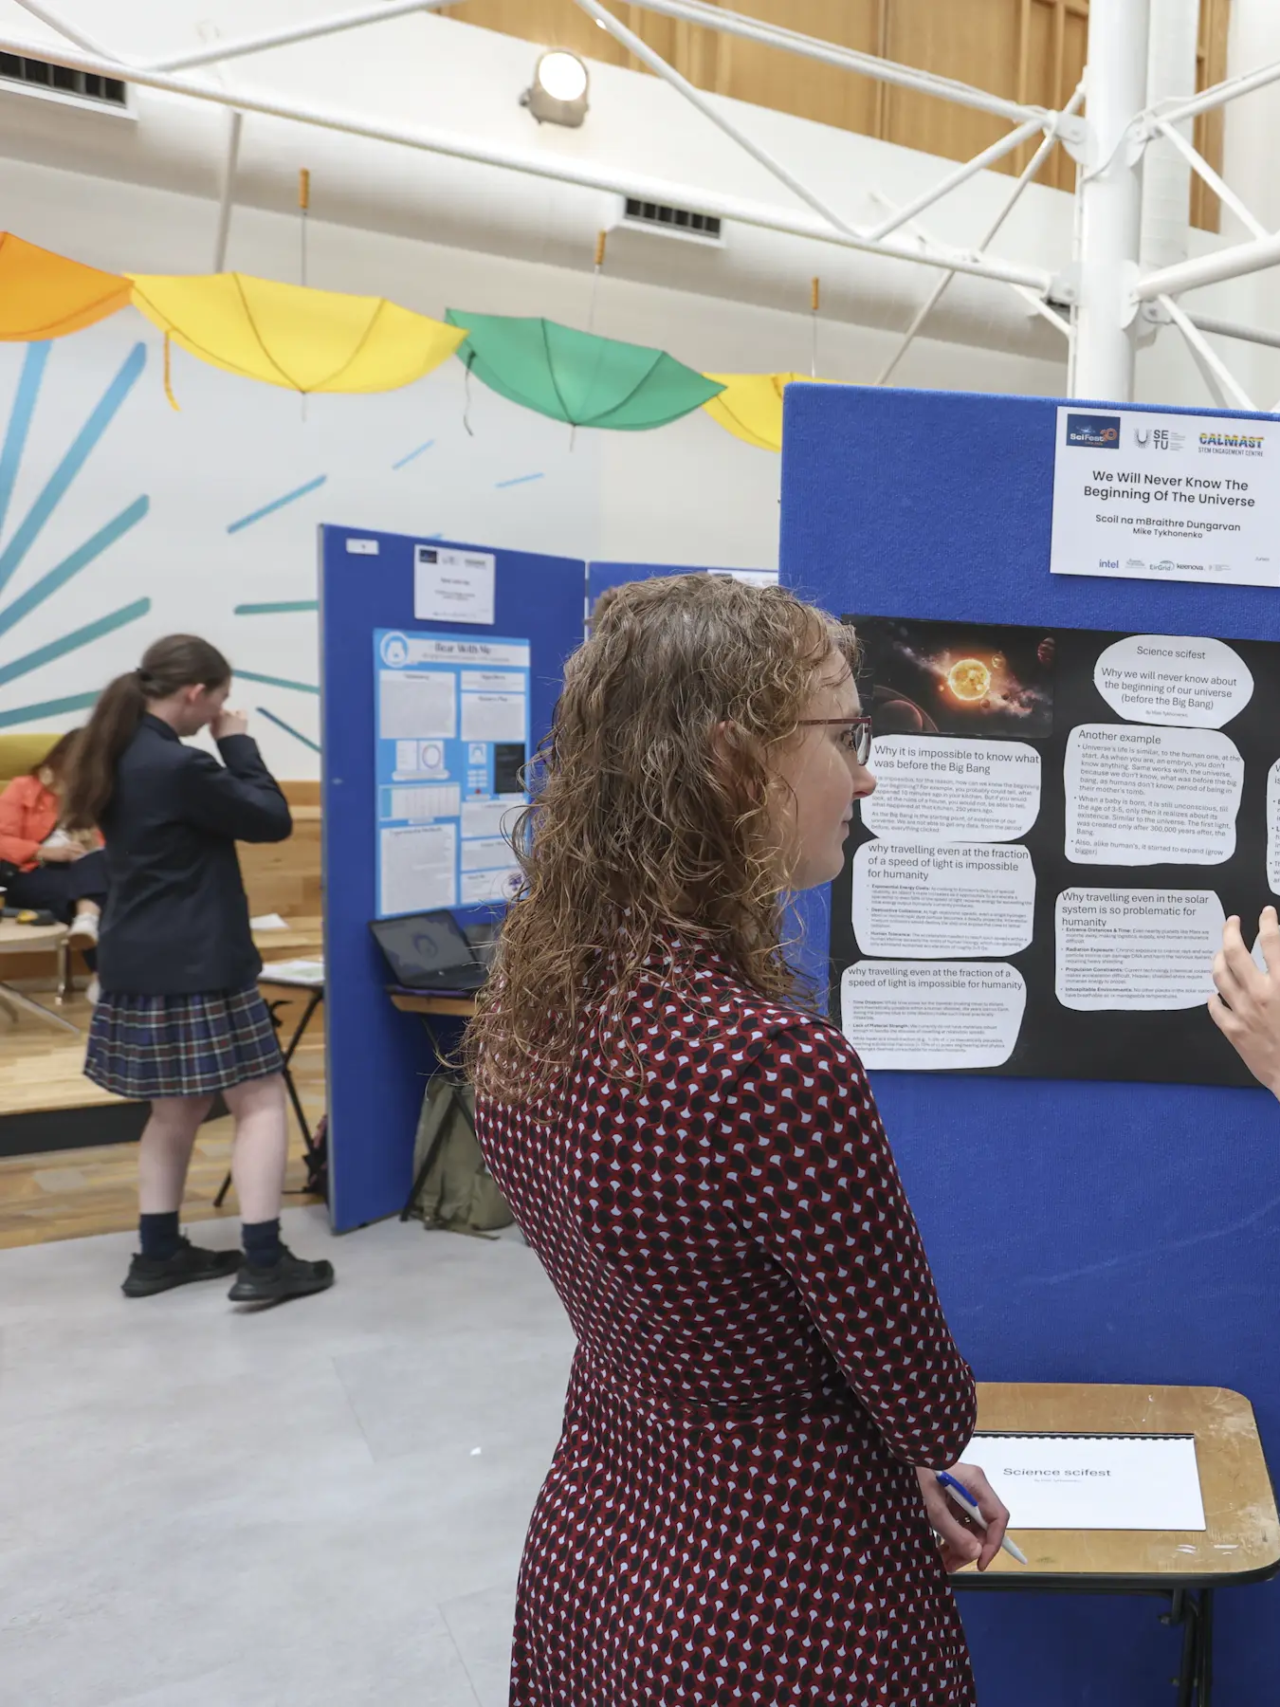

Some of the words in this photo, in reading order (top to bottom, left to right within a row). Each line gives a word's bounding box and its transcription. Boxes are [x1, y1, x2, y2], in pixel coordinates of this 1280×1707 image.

[1070, 432, 1104, 442] SciFest
[1154, 430, 1168, 440] SE
[1199, 433, 1264, 449] CALMAST
[1154, 440, 1168, 450] TU
[1212, 448, 1244, 456] ENGAGEMENT
[1093, 471, 1114, 482] We
[1117, 472, 1141, 484] Will
[1144, 474, 1182, 486] Never
[1186, 477, 1222, 489] Know
[1225, 480, 1248, 491] The
[1084, 486, 1150, 504] Beginning
[1154, 491, 1168, 501] Of
[1172, 492, 1195, 503] The
[1199, 494, 1255, 507] Universe
[1096, 514, 1119, 523] Scoil
[1136, 518, 1185, 528] mBraithre
[1187, 520, 1241, 532] Dungarvan
[1154, 530, 1203, 539] Tykhonenko
[1099, 559, 1119, 569] intel
[1137, 646, 1173, 657] Science
[1175, 650, 1206, 660] scifest
[1102, 667, 1123, 679] Why
[1140, 671, 1156, 680] will
[1158, 674, 1183, 682] never
[1185, 674, 1209, 684] know
[1211, 676, 1237, 686] about
[1105, 680, 1120, 690] the
[1122, 682, 1165, 695] beginning
[1166, 685, 1176, 694] of
[1194, 688, 1232, 698] universe
[1122, 694, 1154, 704] (before
[1155, 697, 1170, 706] the
[1172, 698, 1186, 709] Big
[1188, 699, 1214, 710] Bang)
[1079, 730, 1118, 741] Another
[1120, 734, 1161, 745] example
[875, 745, 898, 757] Why
[899, 747, 906, 756] it
[919, 748, 972, 760] impossible
[974, 752, 984, 760] to
[987, 752, 1013, 762] know
[1015, 754, 1040, 764] what
[897, 760, 928, 770] before
[931, 762, 947, 771] the
[949, 762, 964, 774] Big
[966, 763, 990, 776] Bang
[868, 844, 889, 855] why
[891, 845, 935, 857] travelling
[962, 848, 972, 856] at
[974, 848, 990, 858] the
[992, 849, 1030, 859] fraction
[888, 859, 919, 868] speed
[921, 859, 931, 867] of
[933, 860, 953, 870] light
[966, 862, 1019, 871] impossible
[868, 870, 881, 878] for
[883, 870, 929, 882] humanity
[1062, 893, 1084, 903] Why
[1086, 894, 1130, 904] travelling
[1167, 895, 1183, 903] the
[1185, 895, 1209, 904] solar
[1062, 906, 1097, 915] system
[1123, 907, 1181, 916] problematic
[1183, 908, 1196, 916] for
[1062, 918, 1107, 927] humanity
[848, 967, 867, 977] why
[868, 968, 909, 978] travelling
[959, 969, 993, 977] fraction
[995, 969, 1004, 977] of
[849, 979, 876, 988] speed
[888, 979, 907, 989] light
[918, 980, 966, 989] impossible
[982, 981, 1022, 991] humanity
[1002, 1468, 1060, 1477] Science
[1064, 1468, 1112, 1477] scifest
